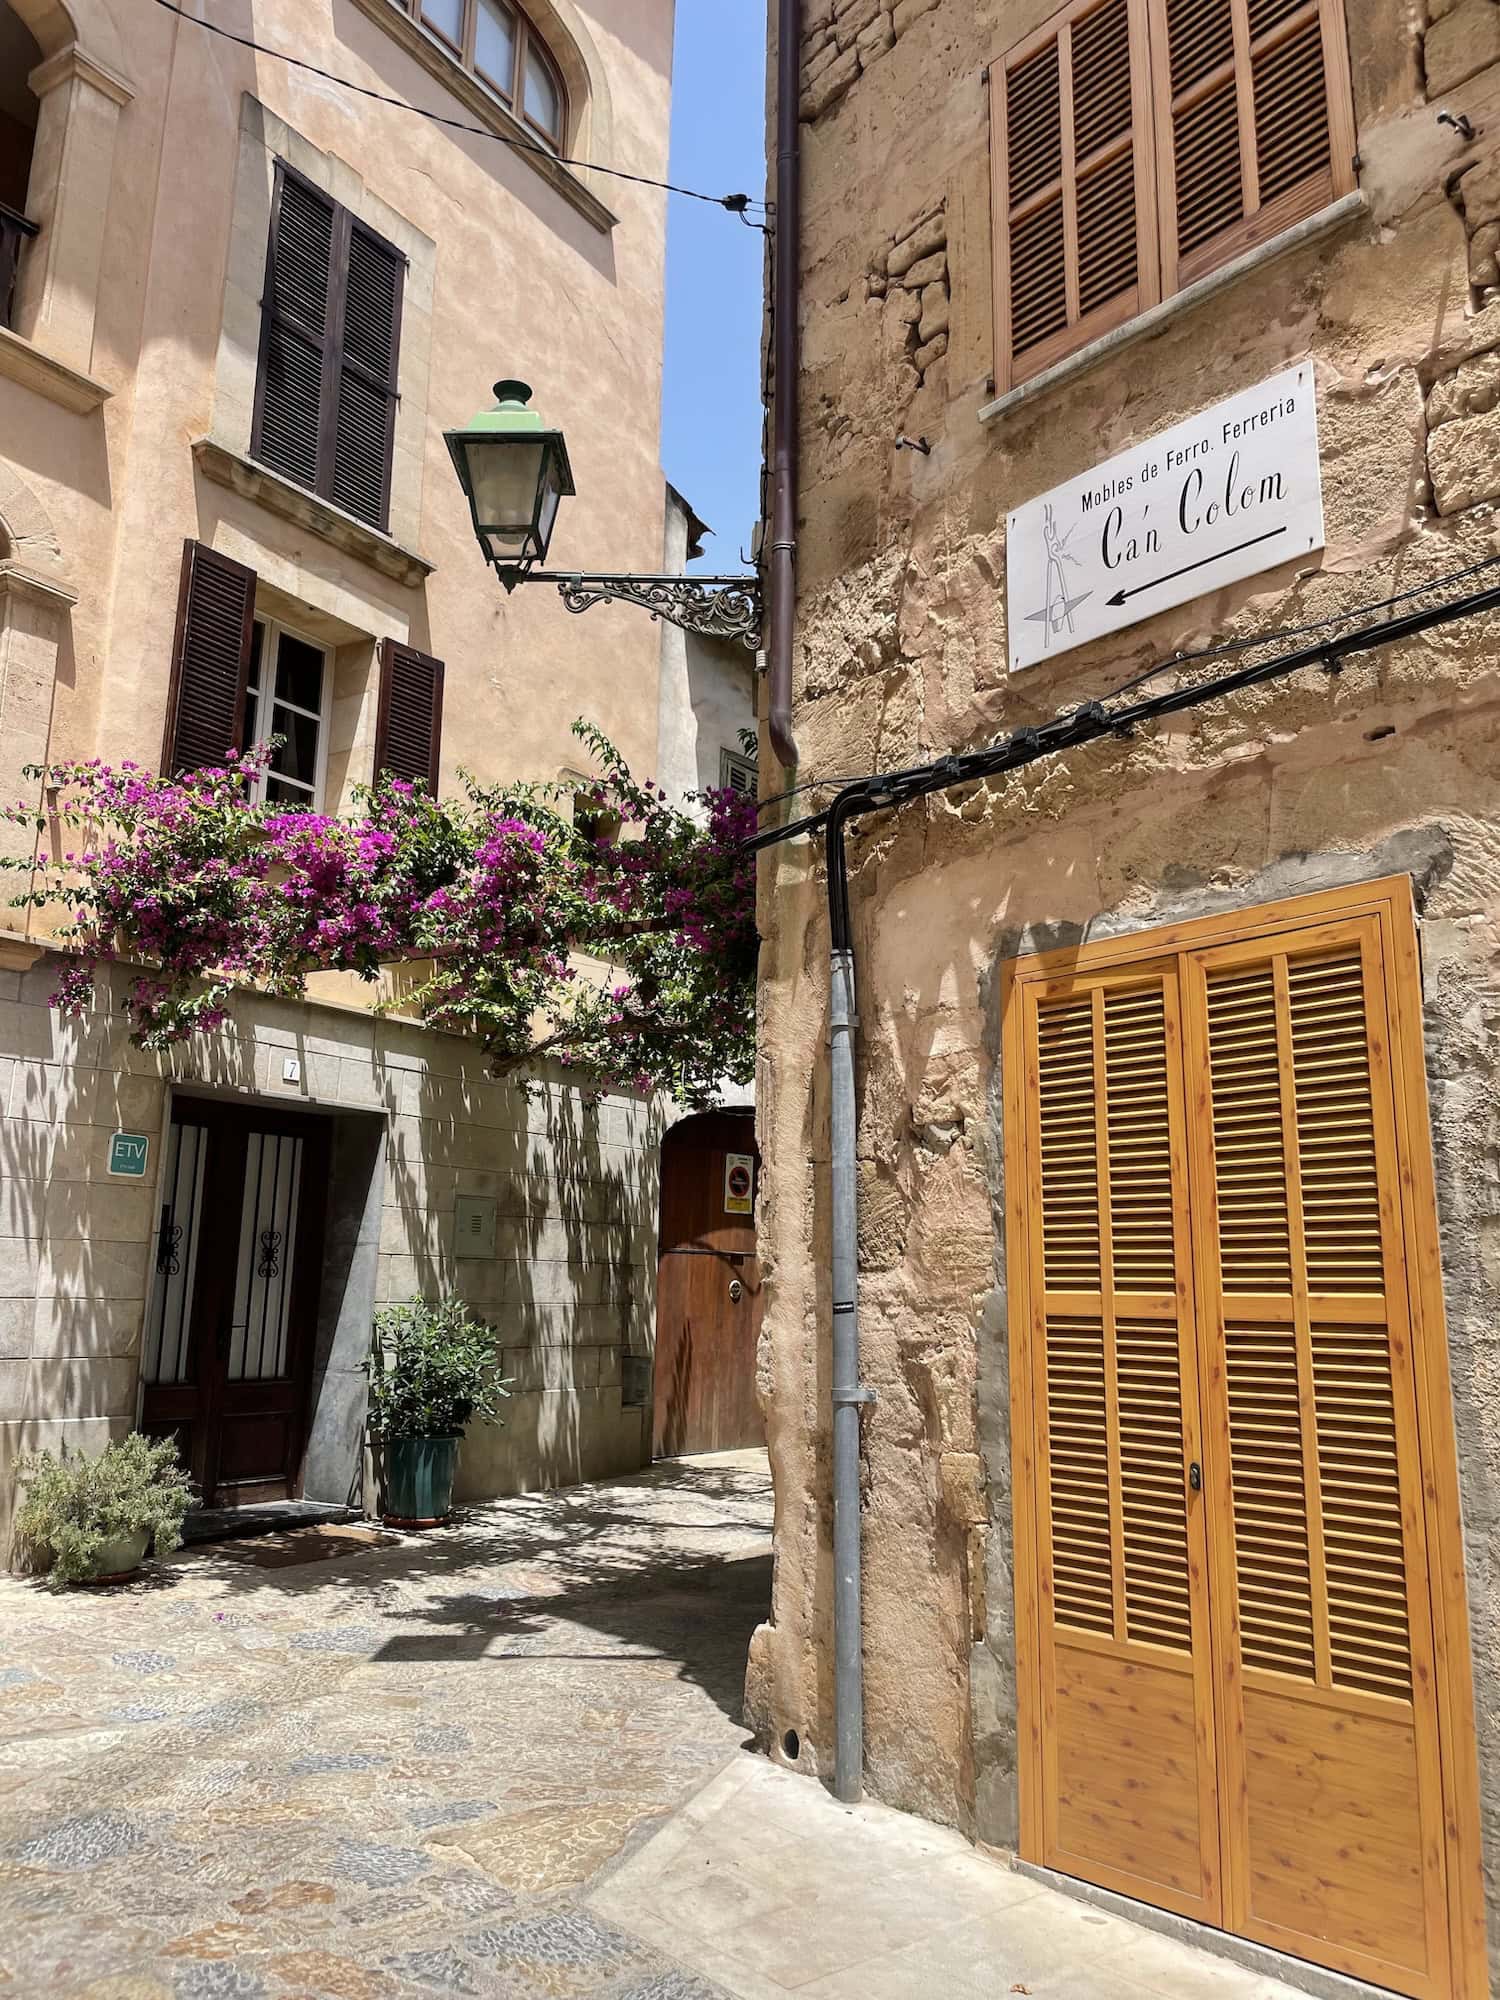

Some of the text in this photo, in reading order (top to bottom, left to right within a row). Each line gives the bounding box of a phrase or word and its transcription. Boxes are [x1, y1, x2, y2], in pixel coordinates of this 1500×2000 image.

[1081, 396, 1295, 513] Mobles de Ferro. Ferreria
[1179, 450, 1288, 534] Colom
[290, 1062, 297, 1078] 7
[115, 1141, 145, 1159] ETV
